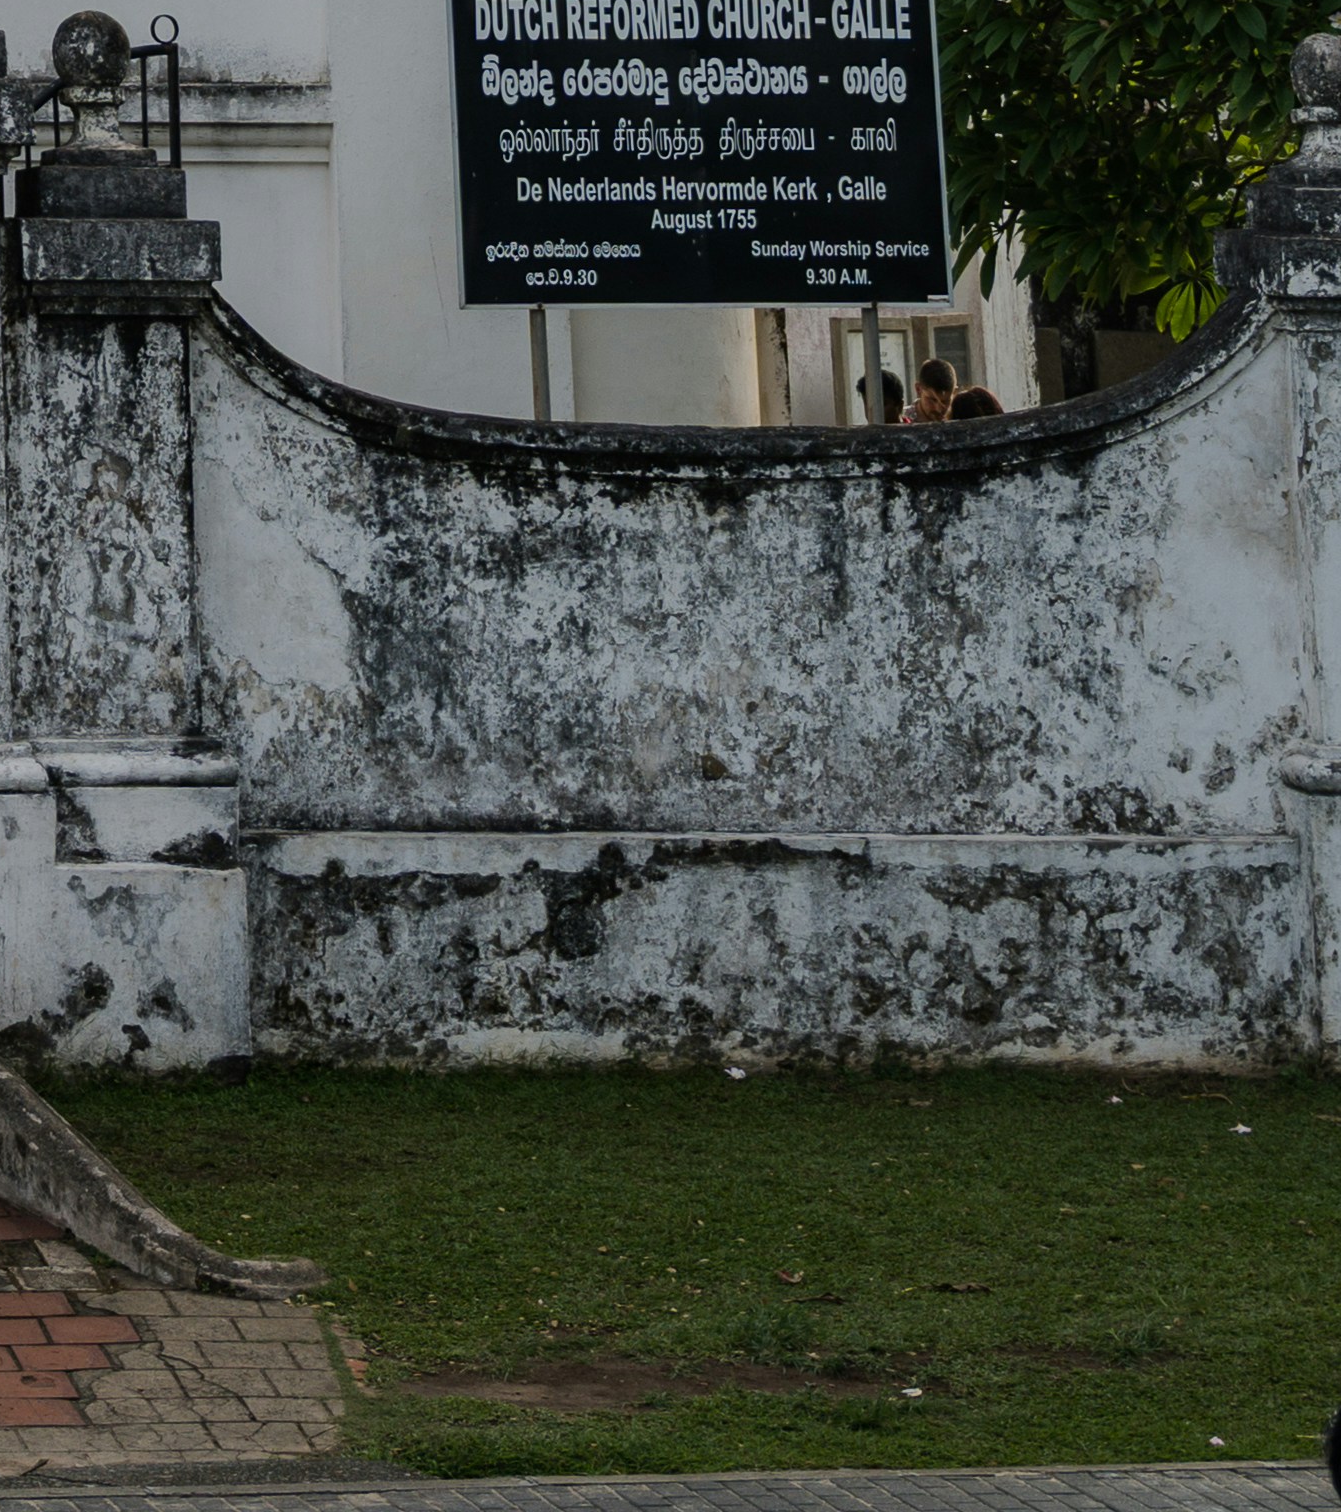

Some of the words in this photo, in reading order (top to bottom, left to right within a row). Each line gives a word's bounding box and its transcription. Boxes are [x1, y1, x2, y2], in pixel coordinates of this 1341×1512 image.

[842, 57, 907, 104] ගාල්ල
[499, 119, 600, 163] ஒல்லாந்தர்
[613, 116, 704, 161] சீர்திருத்த
[719, 116, 815, 161] திருச்சபை
[850, 117, 897, 152] காலி
[516, 177, 543, 202] De
[548, 176, 657, 202] Nederlands
[662, 175, 768, 201] Hervormde
[772, 176, 818, 201] Kerk
[838, 175, 887, 201] Galle
[650, 208, 714, 235] August
[717, 208, 757, 229] 1755
[751, 240, 807, 261] Sunday
[810, 240, 872, 260] Worship
[875, 240, 930, 258] Service
[805, 268, 837, 285] 9.30
[839, 268, 873, 285] A.M.
